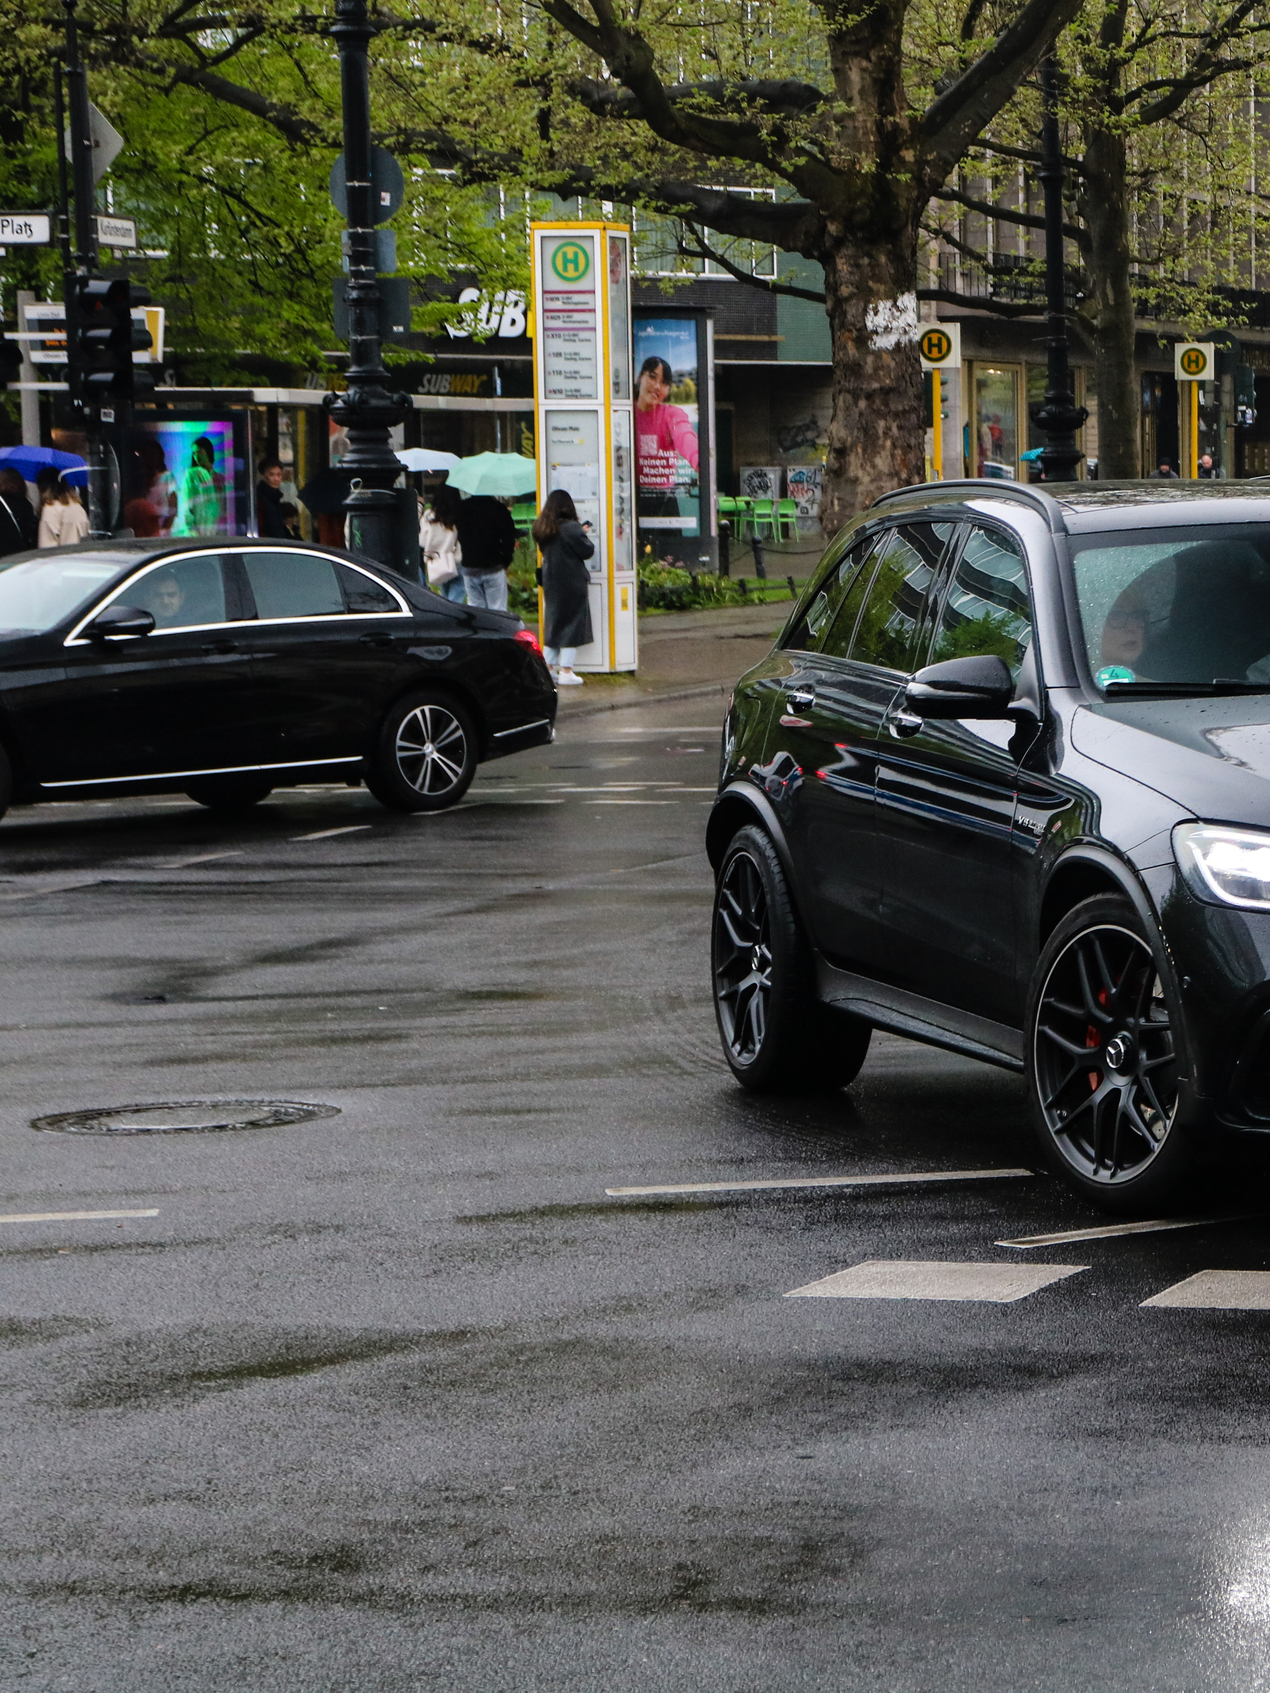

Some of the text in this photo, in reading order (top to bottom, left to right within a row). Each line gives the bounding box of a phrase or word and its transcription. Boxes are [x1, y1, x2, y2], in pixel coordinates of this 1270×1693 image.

[1, 219, 33, 238] Platz
[562, 251, 579, 272] H
[446, 287, 532, 340] SUB
[927, 336, 943, 355] H
[1187, 354, 1200, 369] H
[418, 373, 487, 394] SUBWAY
[658, 448, 678, 457] Aus:
[639, 457, 667, 466] Keinen
[640, 474, 692, 484] Deinen Plan.
[642, 466, 676, 475] Machen
